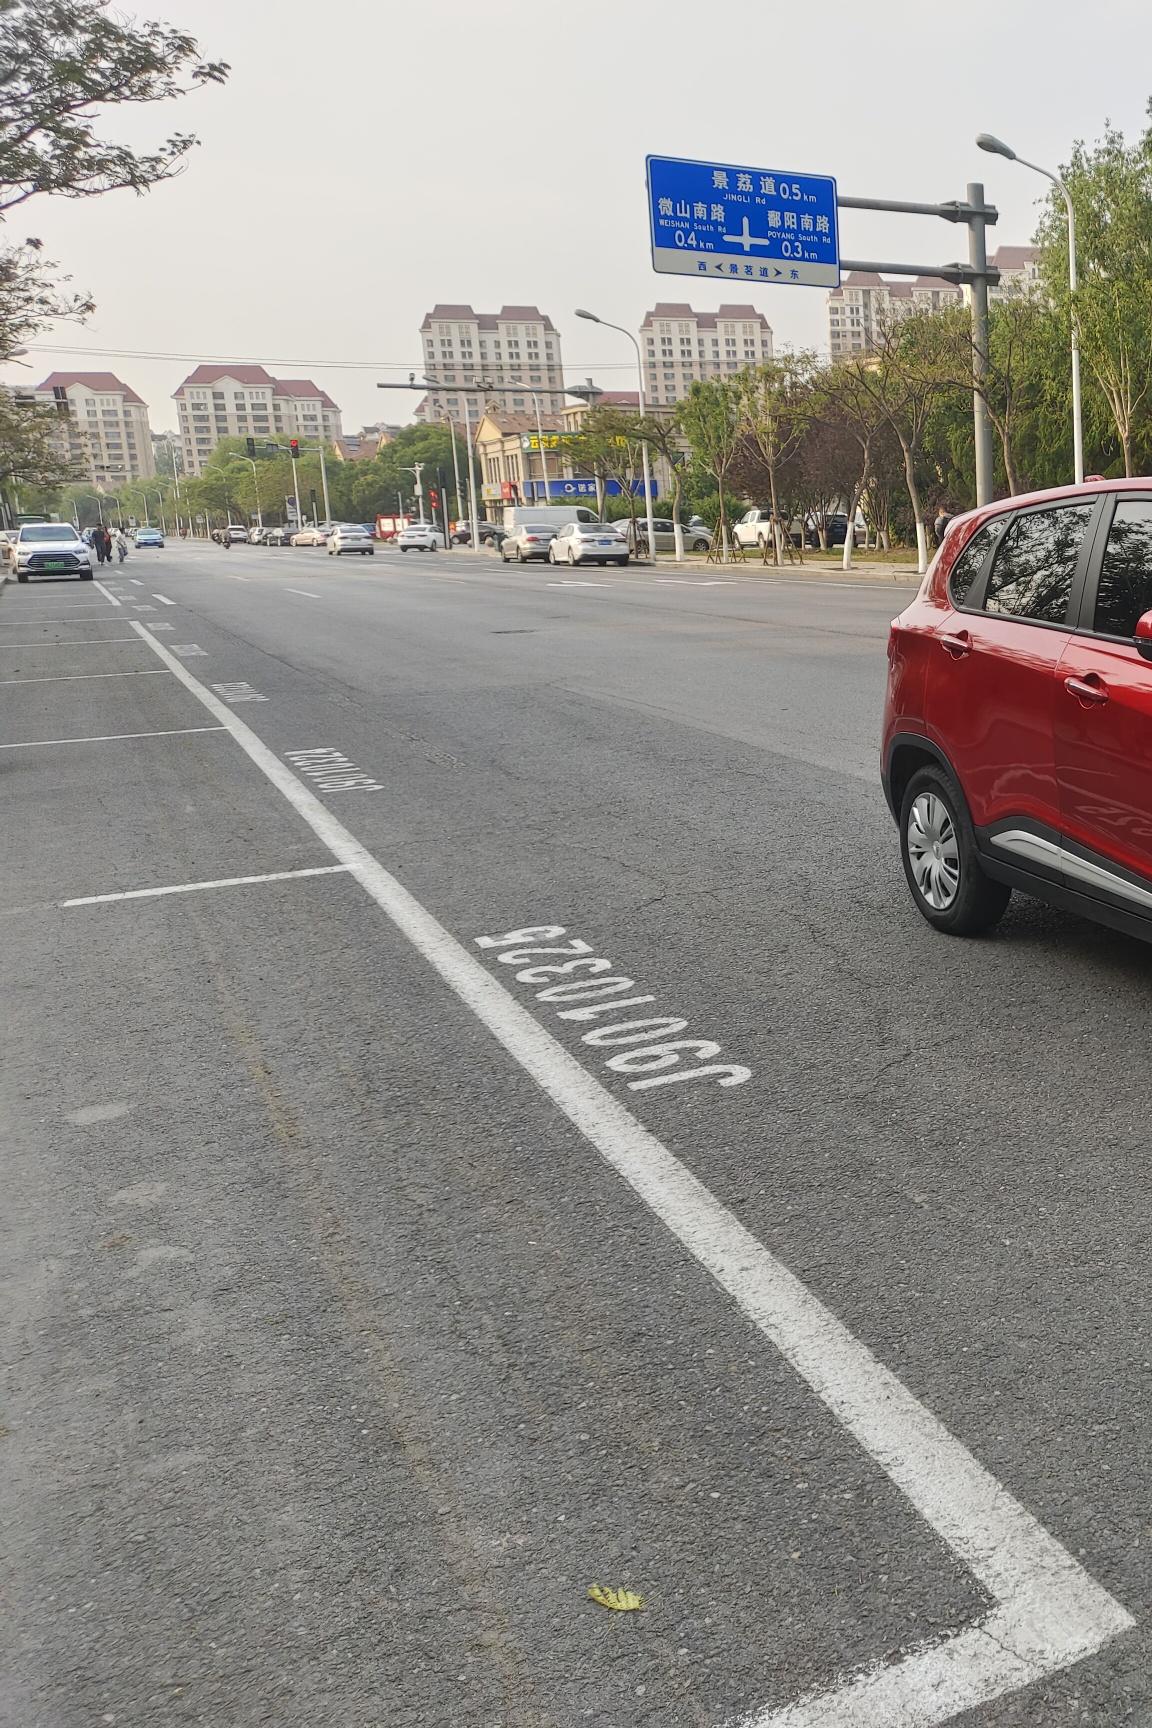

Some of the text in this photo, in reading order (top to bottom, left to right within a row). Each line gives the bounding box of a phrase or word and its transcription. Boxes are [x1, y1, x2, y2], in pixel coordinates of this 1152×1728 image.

[711, 170, 817, 203] 景荔道 0.5 km
[723, 192, 766, 205] JINGLI Rd
[658, 197, 726, 223] 微山南路
[659, 218, 727, 234] WEISHAN South Rd
[767, 210, 830, 234] 鄱阳南路
[675, 229, 714, 250] 0.4 km
[767, 230, 831, 244] POYANG South Rd
[781, 240, 818, 260] 0.3 km
[697, 260, 707, 272] 西
[790, 269, 799, 279] 东
[474, 925, 752, 1092] J9010325
